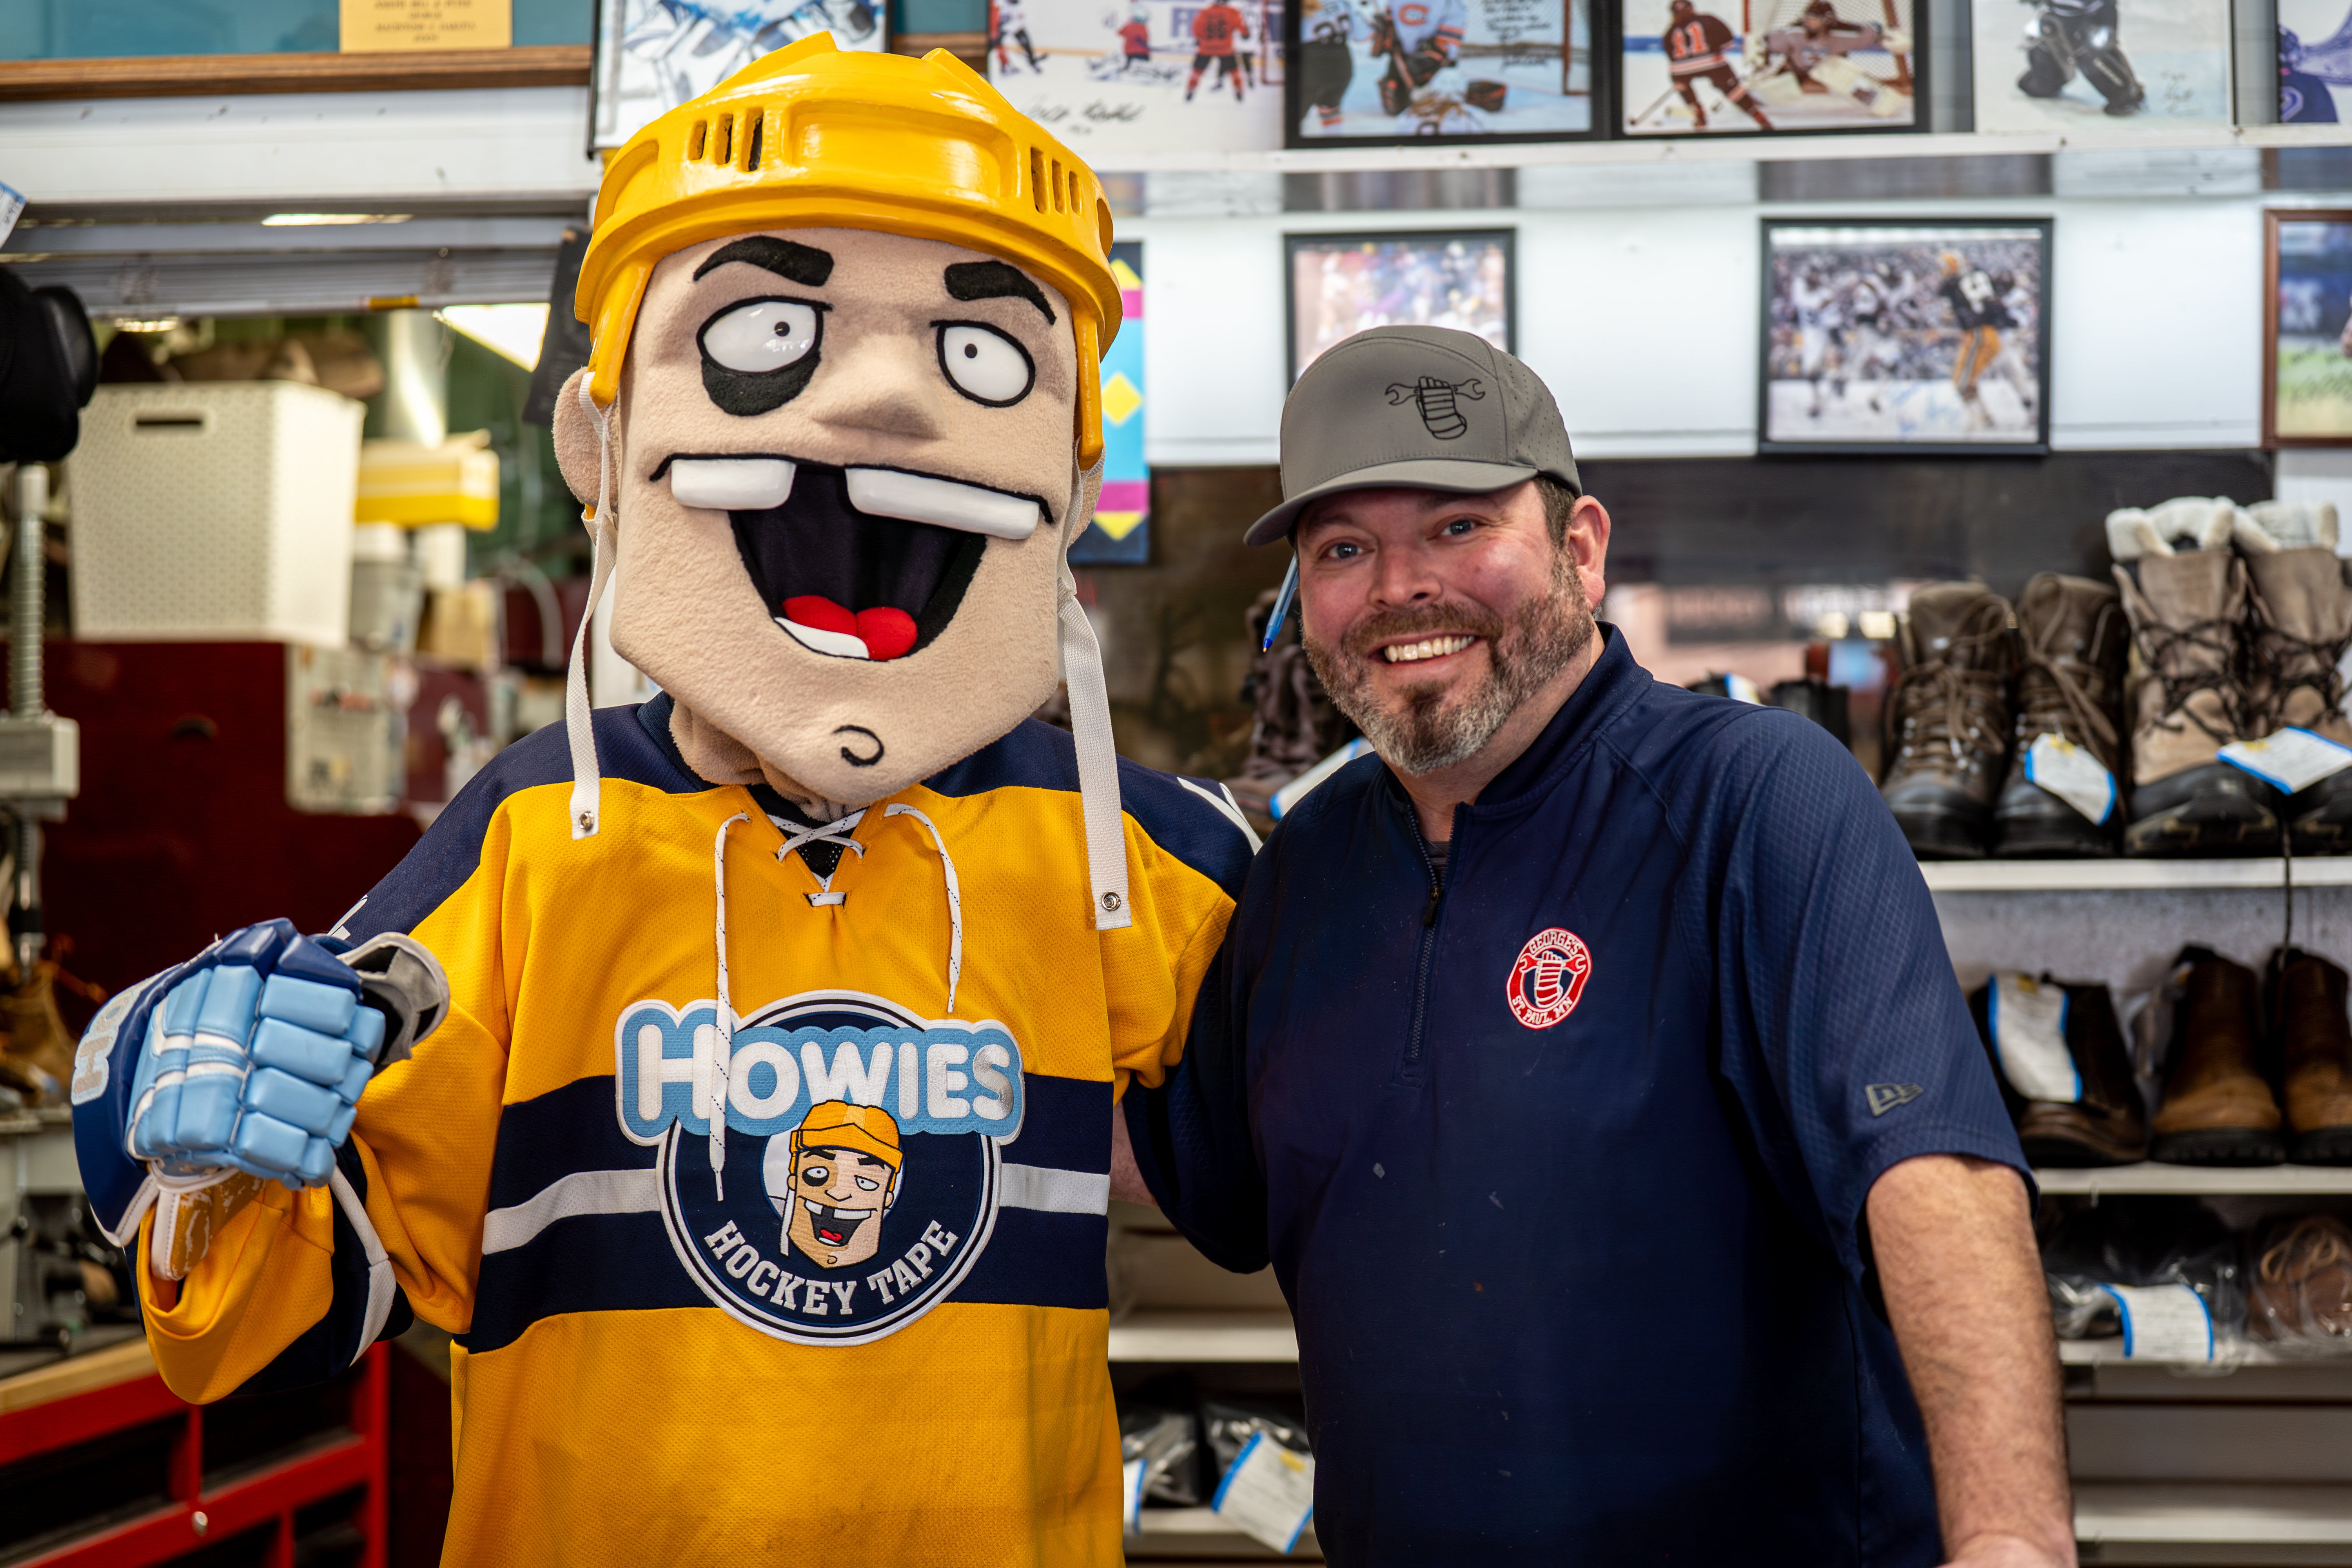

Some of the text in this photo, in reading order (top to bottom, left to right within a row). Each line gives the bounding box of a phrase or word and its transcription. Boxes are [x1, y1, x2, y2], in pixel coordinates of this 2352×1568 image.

[1671, 21, 1710, 59] 11
[1529, 931, 1582, 955] GEORGE'S
[1553, 996, 1573, 1018] MN
[637, 1024, 1014, 1121] HOWIES
[704, 1220, 959, 1315] HOCKEY TAPE
